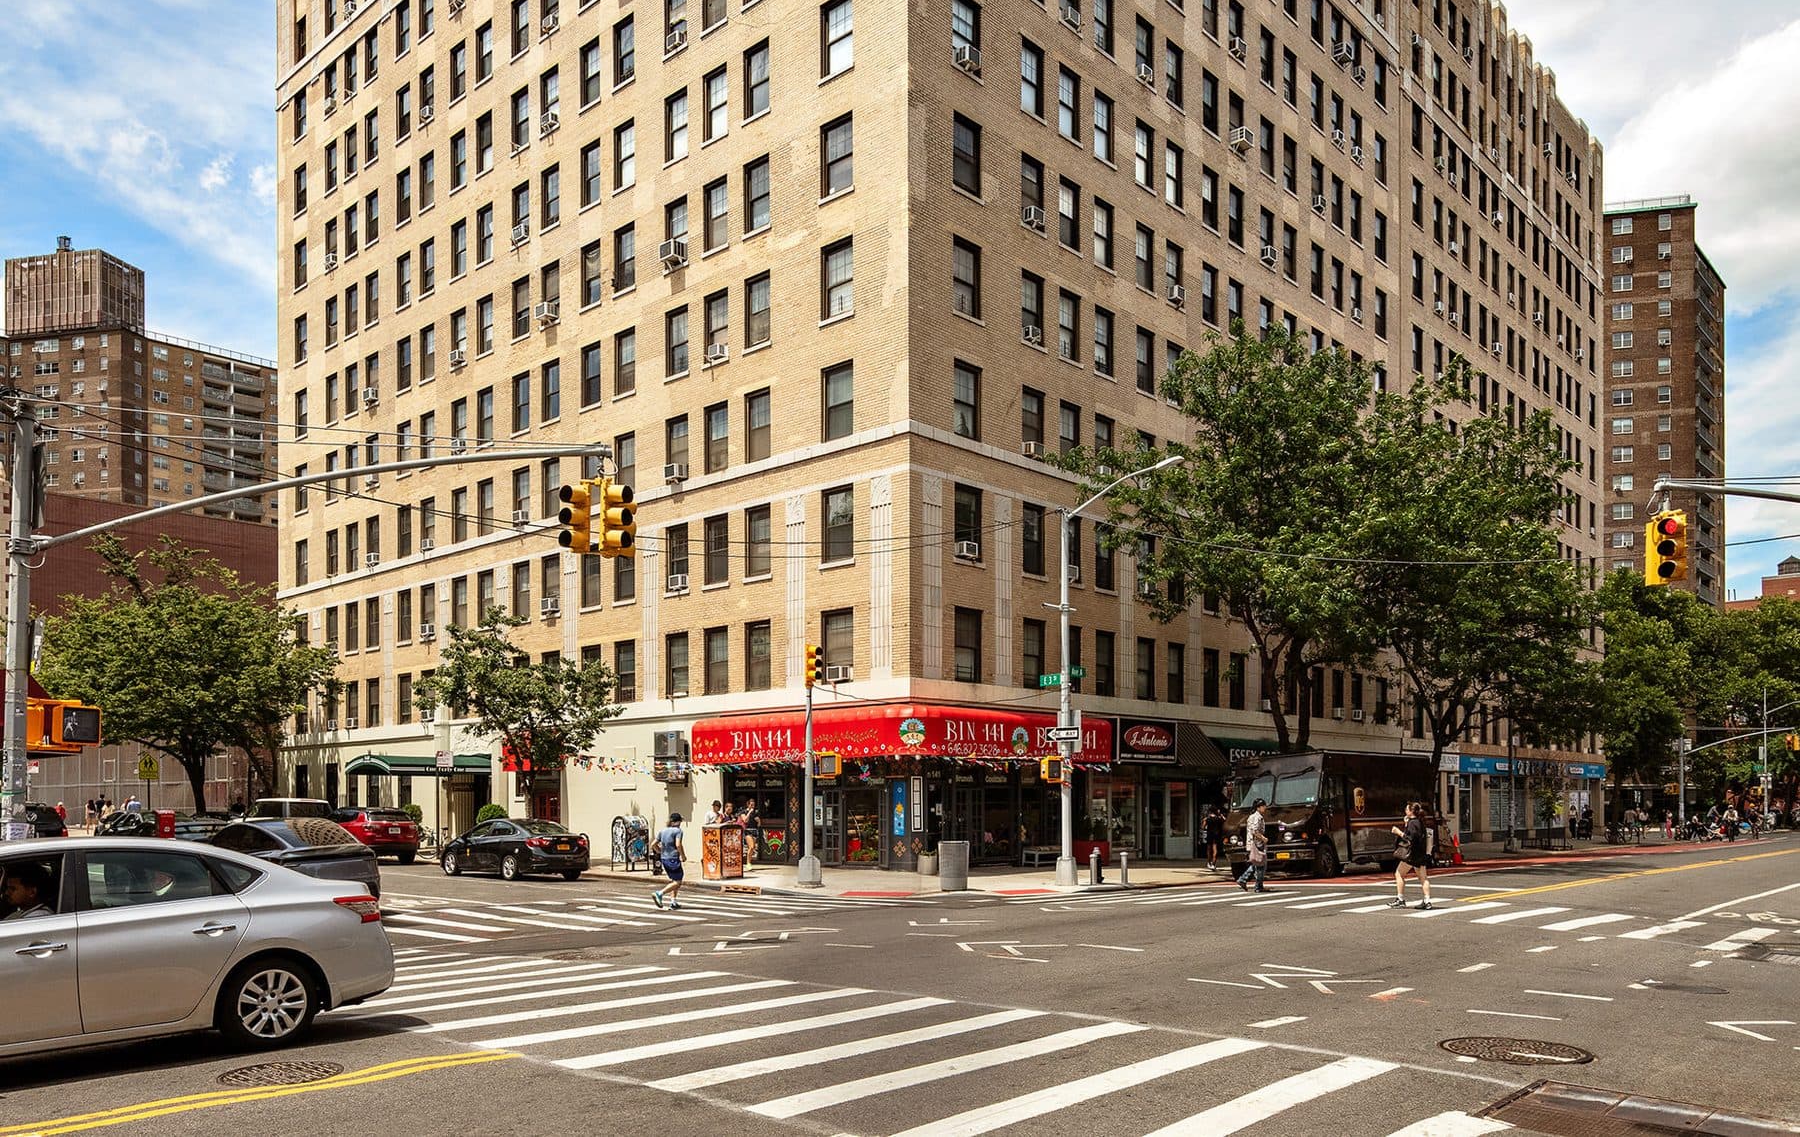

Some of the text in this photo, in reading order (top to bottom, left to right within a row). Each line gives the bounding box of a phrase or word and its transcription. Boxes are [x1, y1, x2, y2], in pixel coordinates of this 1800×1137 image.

[730, 729, 792, 751] BIN 141
[944, 720, 1005, 742] BIN 141
